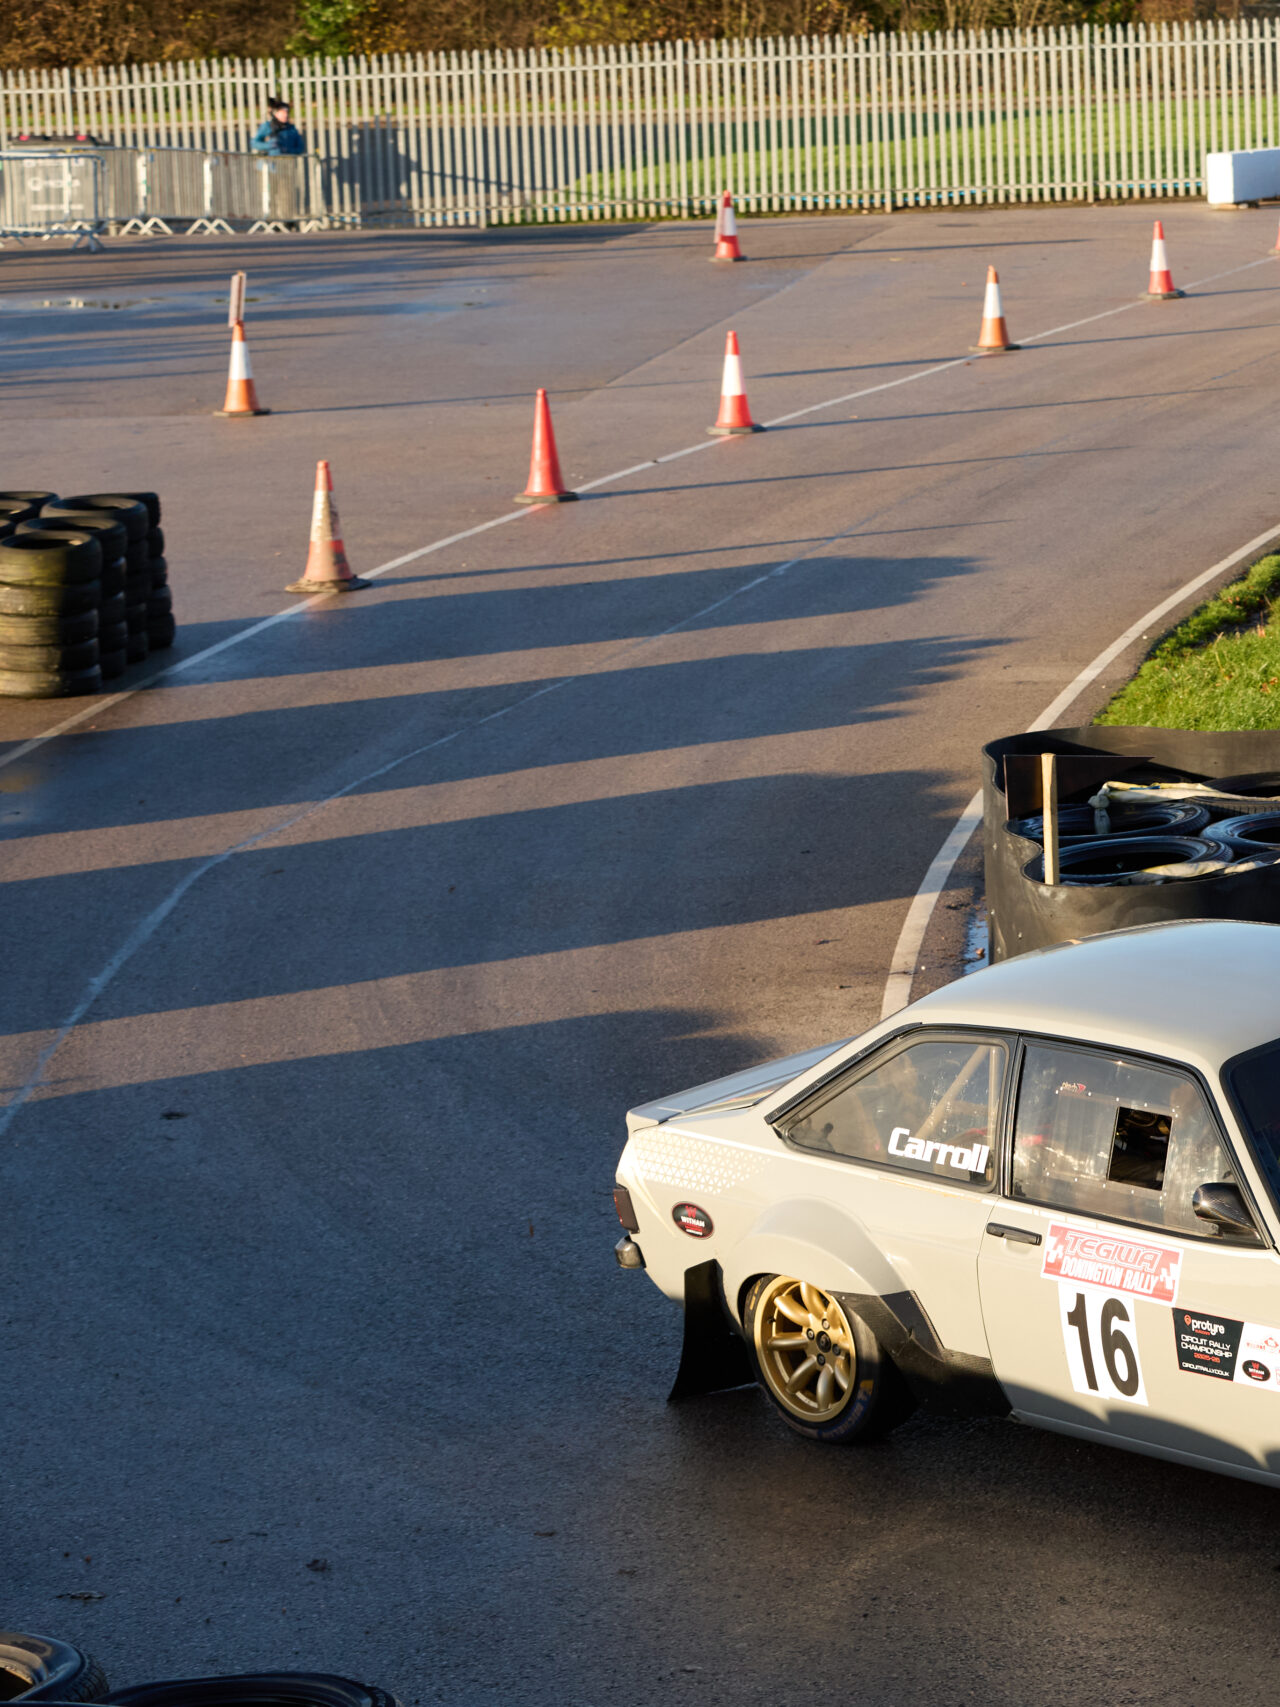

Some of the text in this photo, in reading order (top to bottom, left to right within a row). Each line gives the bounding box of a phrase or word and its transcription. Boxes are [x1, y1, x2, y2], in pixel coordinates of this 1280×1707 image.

[887, 1127, 990, 1174] Carroll
[680, 1215, 705, 1228] WITHAM
[1064, 1232, 1162, 1273] TEGIWA
[1060, 1255, 1161, 1294] DONINGTON RALLY
[1191, 1318, 1225, 1336] protyre
[1066, 1292, 1139, 1397] 16
[1180, 1334, 1231, 1351] CIRCUIT RALLY
[1180, 1342, 1233, 1359] CHAMPIONSHIP
